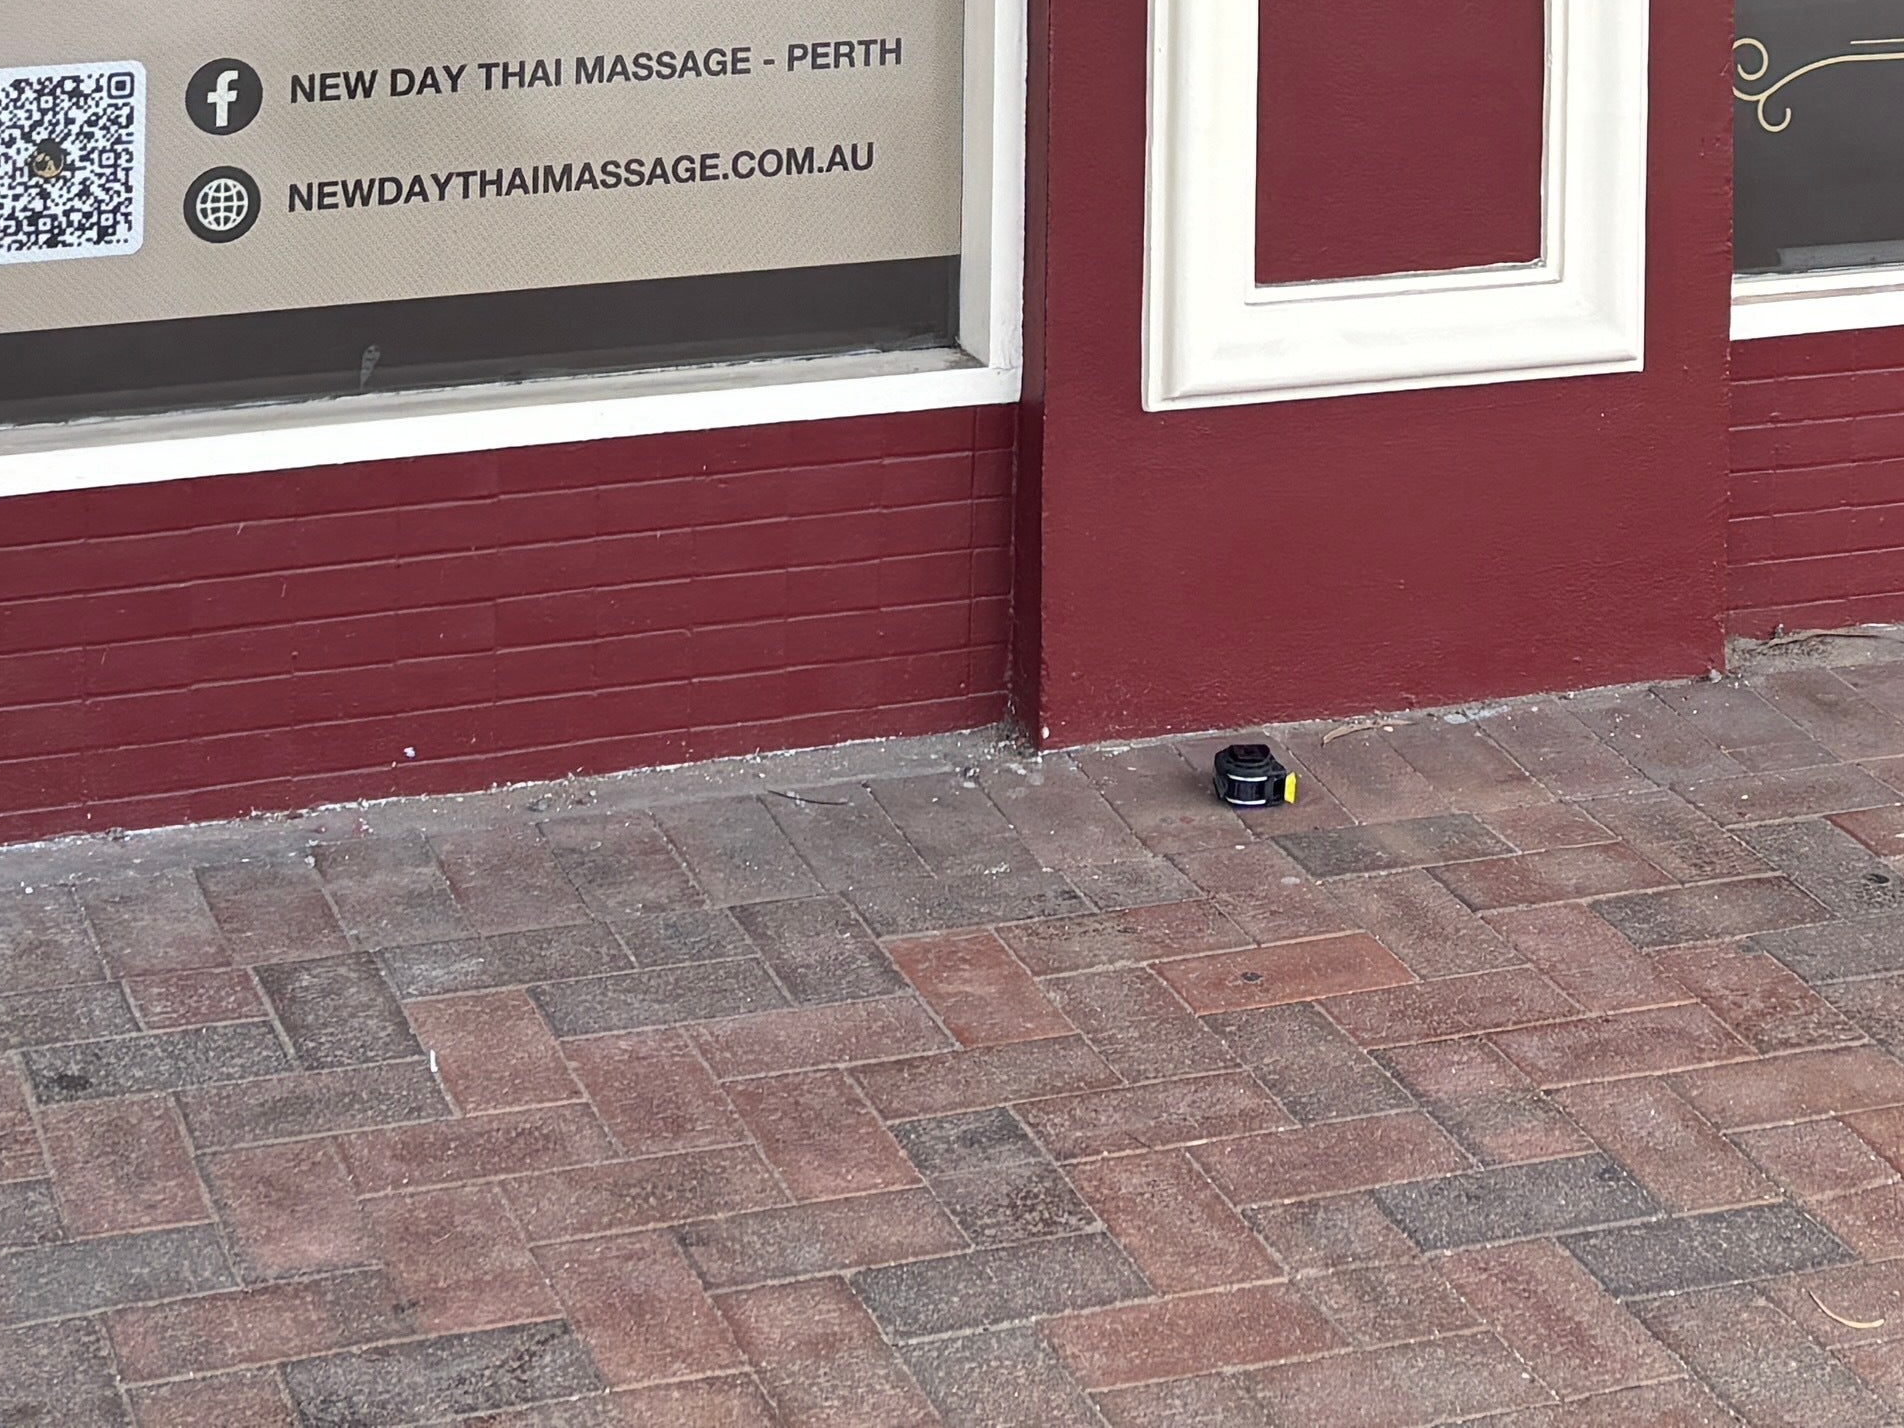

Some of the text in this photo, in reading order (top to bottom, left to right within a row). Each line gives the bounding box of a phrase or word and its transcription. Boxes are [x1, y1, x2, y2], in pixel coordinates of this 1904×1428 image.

[291, 70, 378, 103] NEW
[390, 65, 467, 96] DAY
[478, 59, 561, 90] THAI
[576, 47, 751, 84] MASSAGE
[788, 38, 901, 71] PERTH
[289, 142, 873, 212] NEWDAYTHAIMASSAGE.COM.AU
